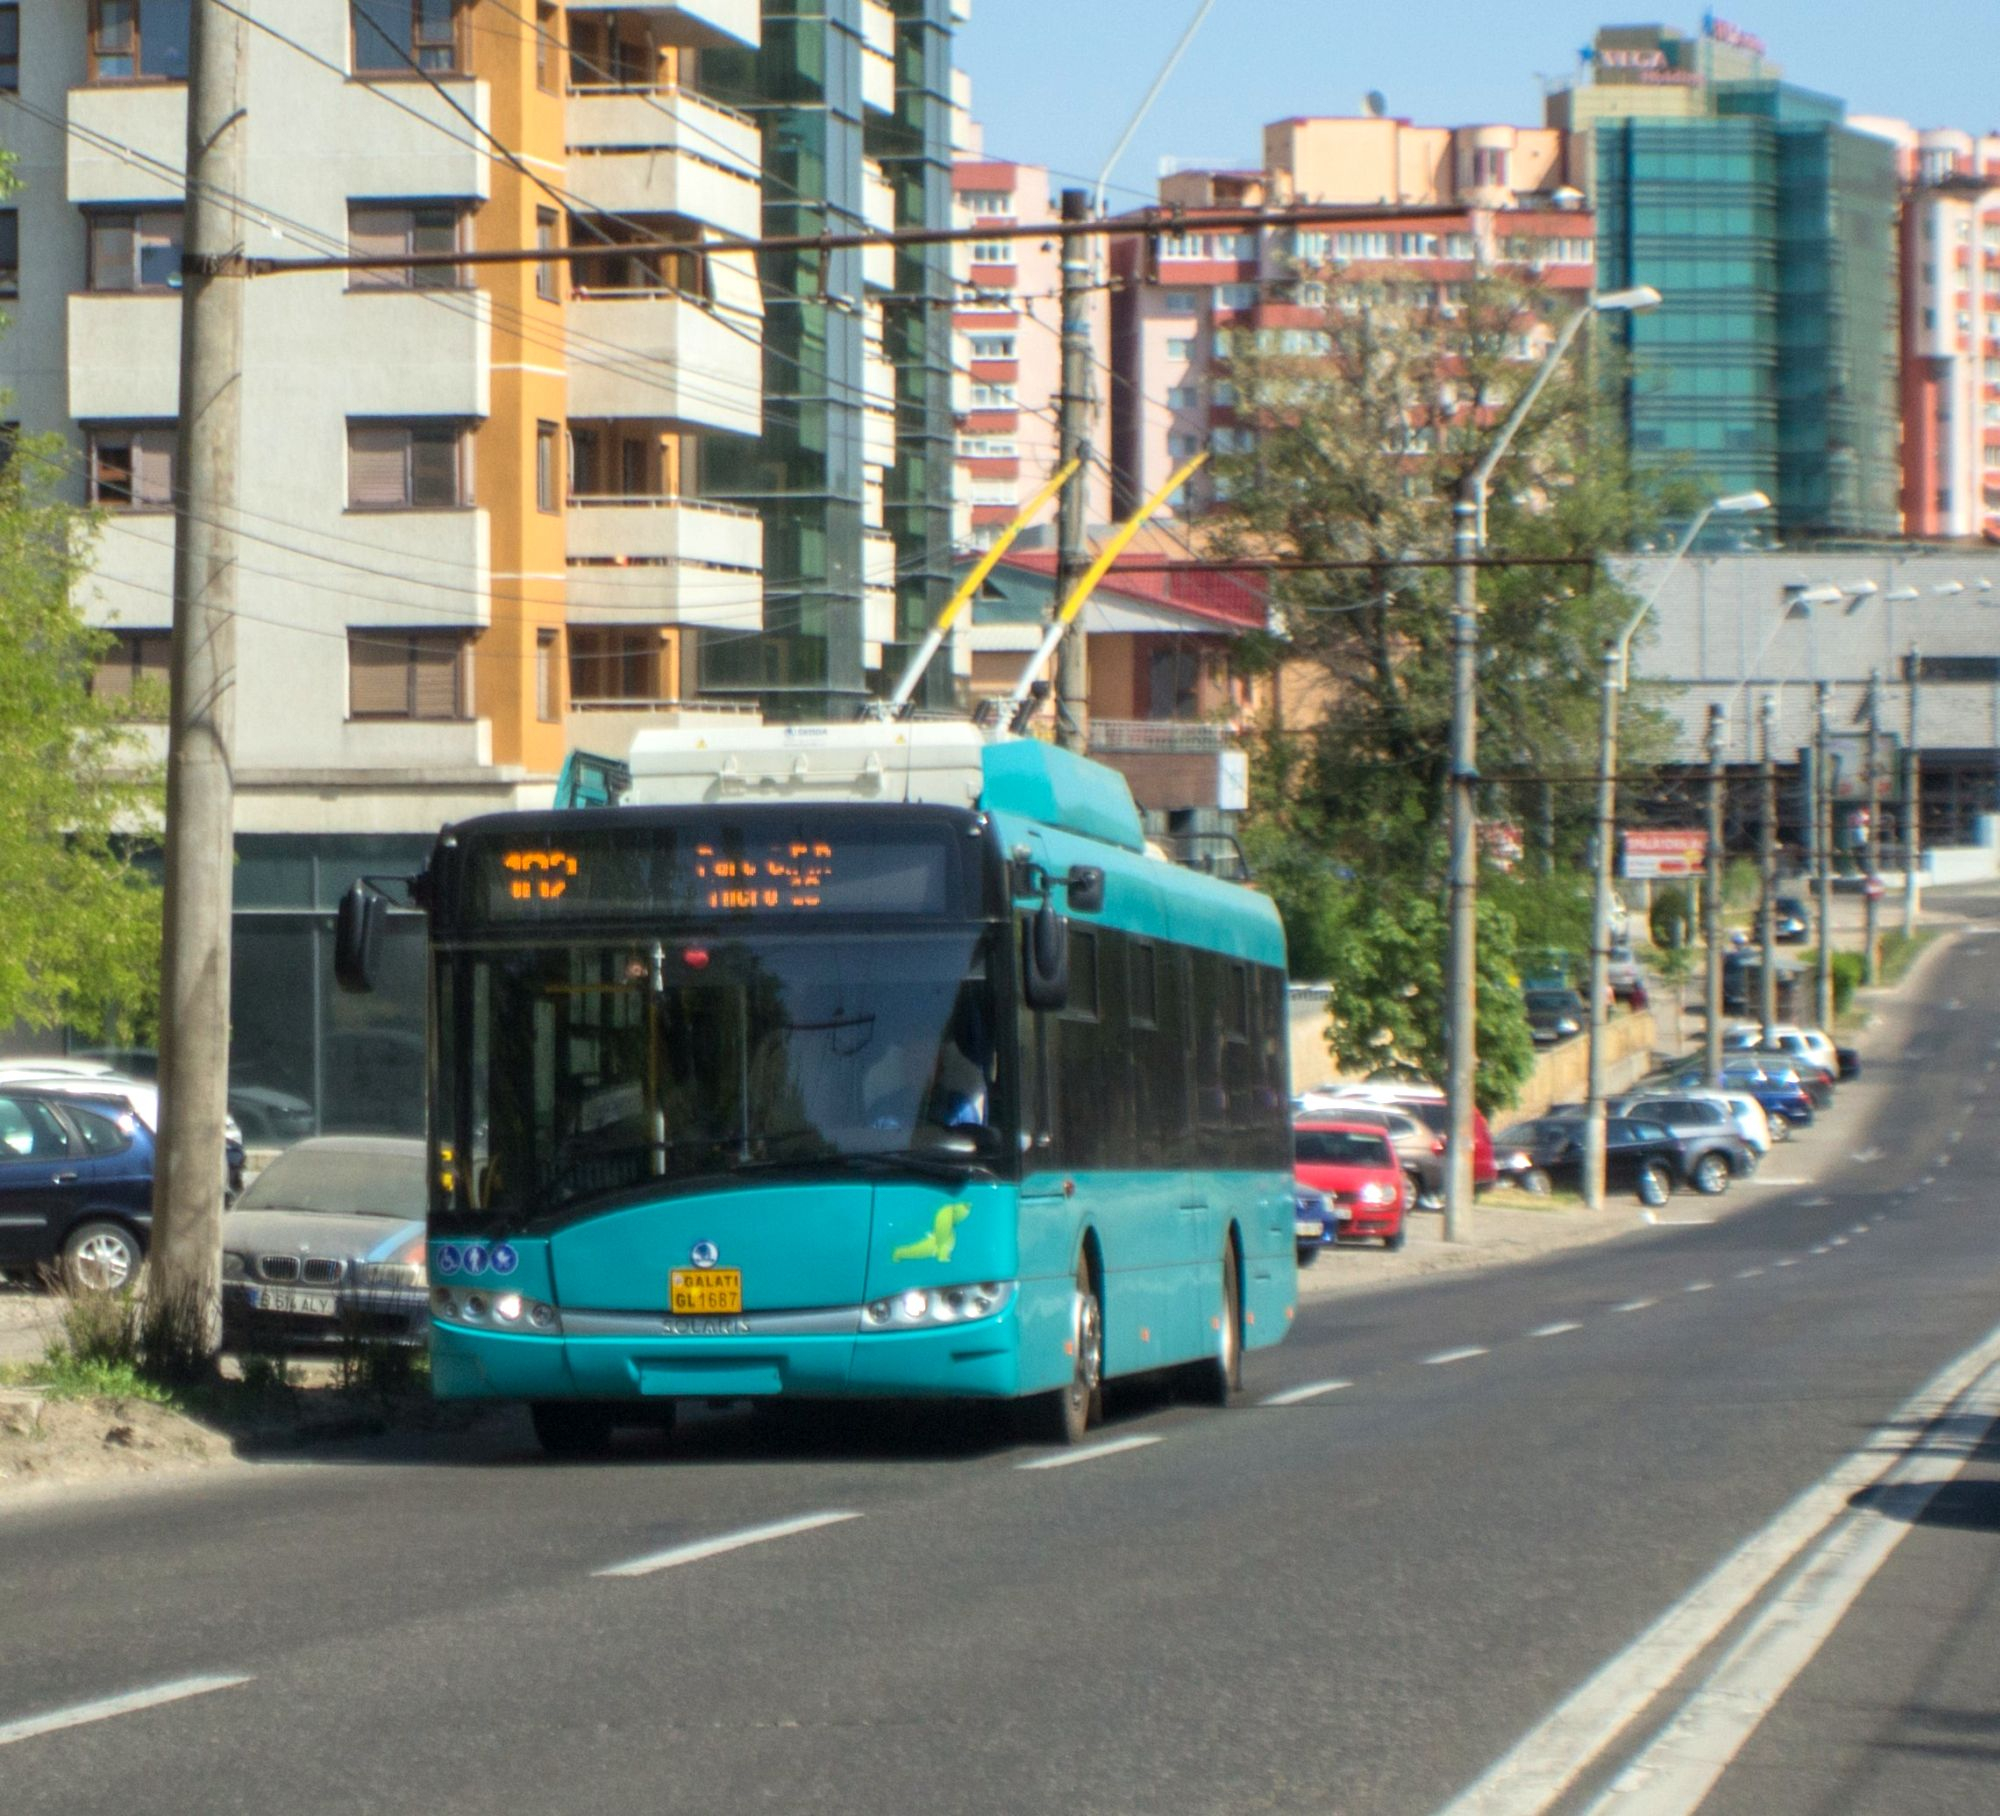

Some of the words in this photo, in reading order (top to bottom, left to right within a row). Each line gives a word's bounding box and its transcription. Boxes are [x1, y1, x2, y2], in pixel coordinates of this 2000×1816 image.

[683, 1275, 739, 1289] GALATI
[302, 1297, 329, 1314] ALY
[676, 1293, 696, 1309] GL
[699, 1291, 738, 1309] 1687
